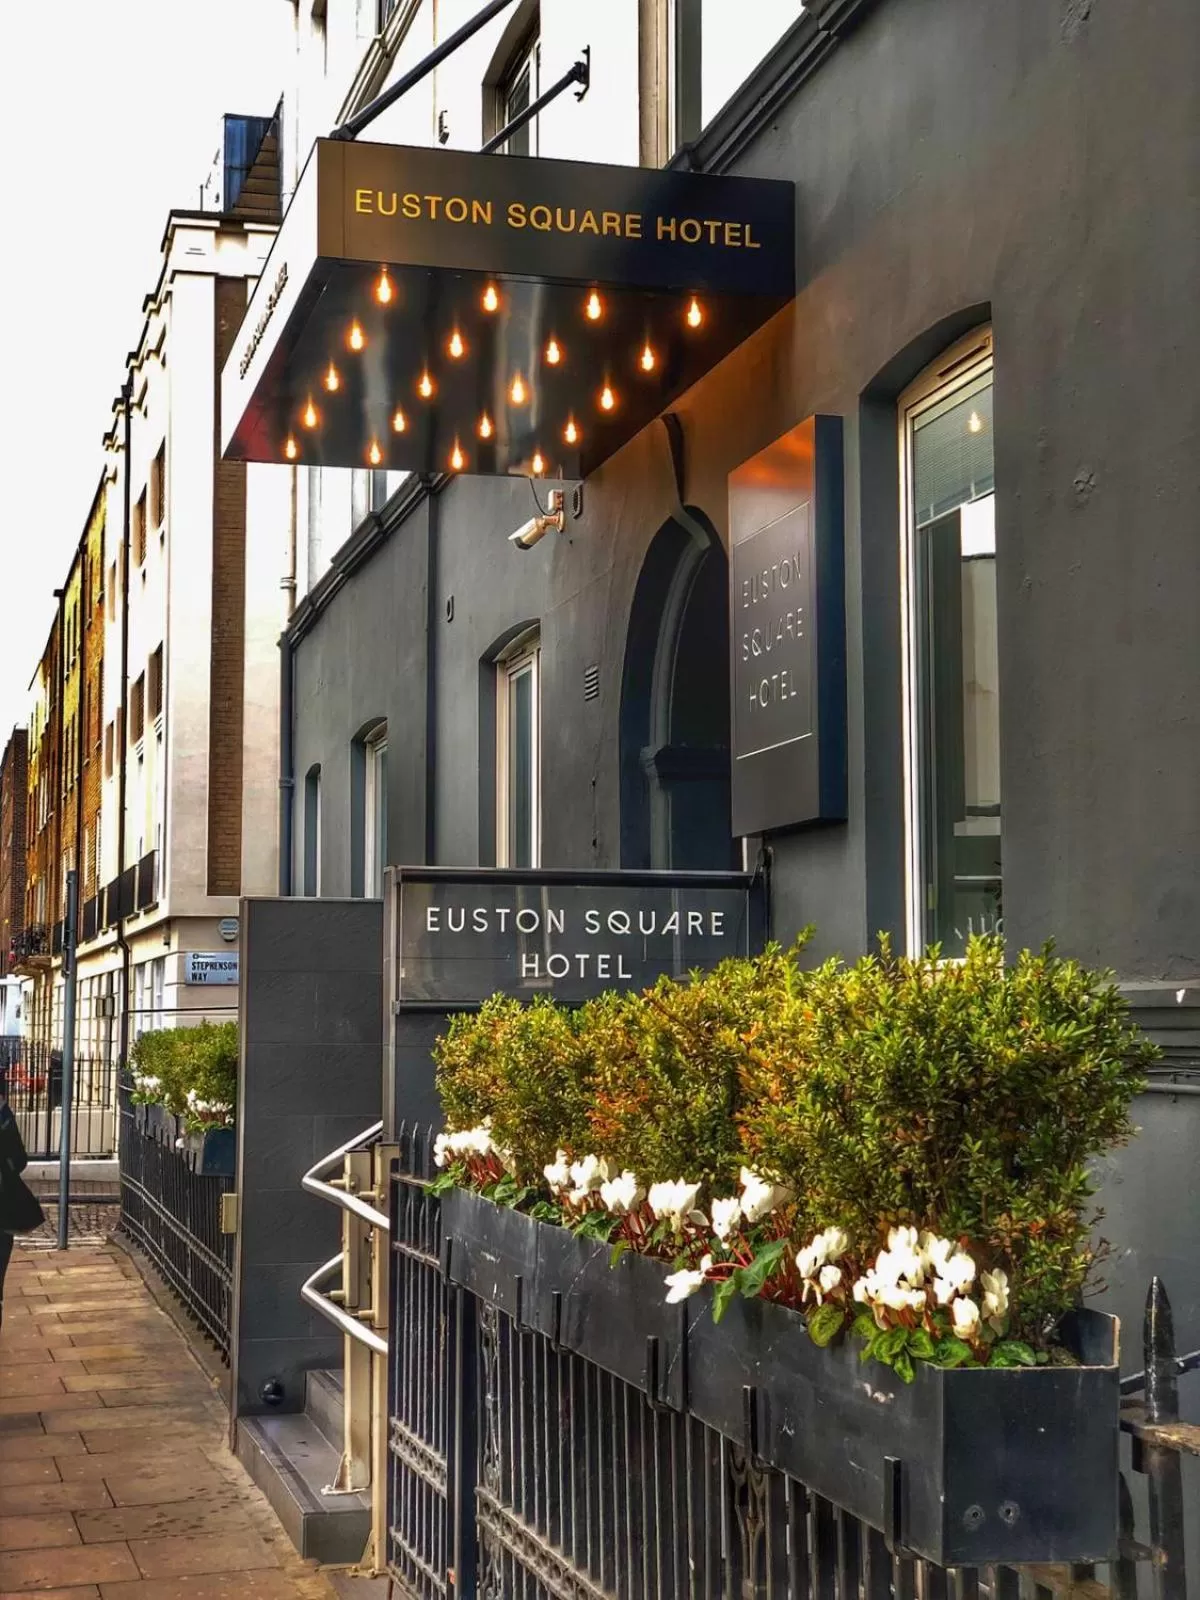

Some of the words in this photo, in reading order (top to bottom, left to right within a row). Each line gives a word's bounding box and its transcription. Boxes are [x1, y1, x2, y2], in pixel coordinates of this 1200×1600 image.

[354, 188, 492, 225] EUSTON
[507, 203, 643, 239] SQUARE
[656, 216, 762, 250] HOTEL
[743, 551, 802, 608] EUSTON
[742, 607, 804, 662] SQUARE
[748, 669, 797, 713] HOTEL
[425, 906, 566, 935] EUSTON
[584, 909, 725, 937] SQUARE
[191, 961, 238, 971] STEPHENSON
[191, 972, 207, 982] WAY
[521, 953, 633, 980] HOTEL
